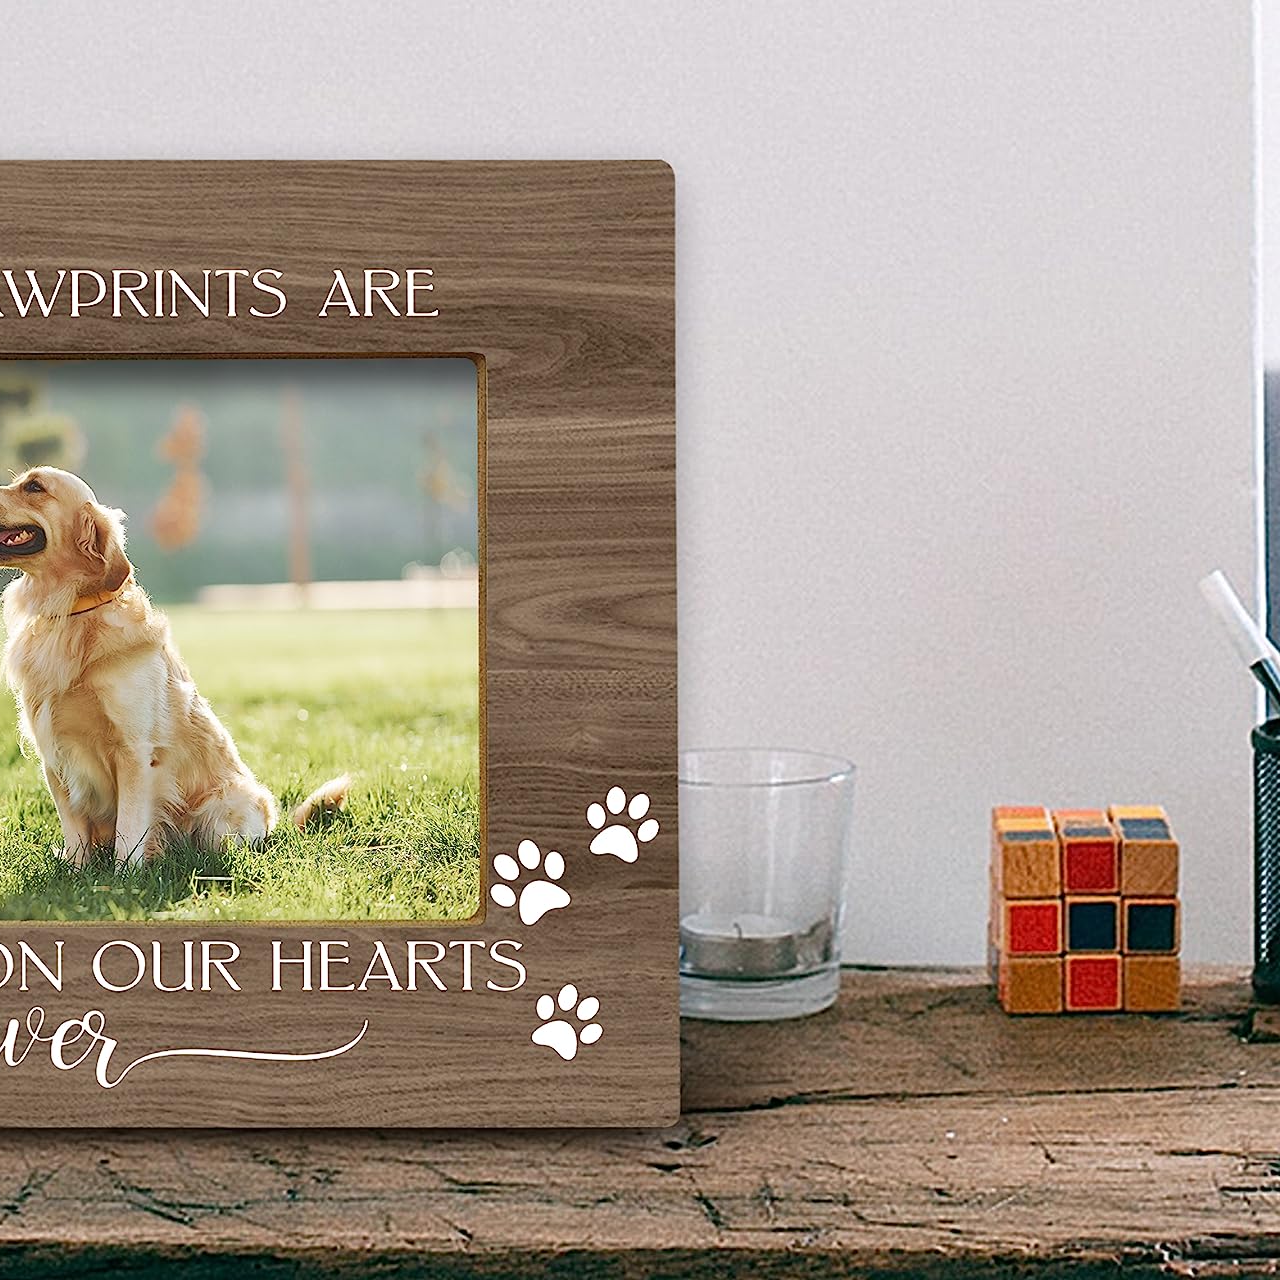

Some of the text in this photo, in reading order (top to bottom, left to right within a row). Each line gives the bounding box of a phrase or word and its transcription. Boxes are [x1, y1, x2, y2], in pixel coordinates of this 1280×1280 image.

[318, 269, 439, 317] ARE
[92, 940, 242, 992] OUR
[271, 940, 526, 992] HEARTS
